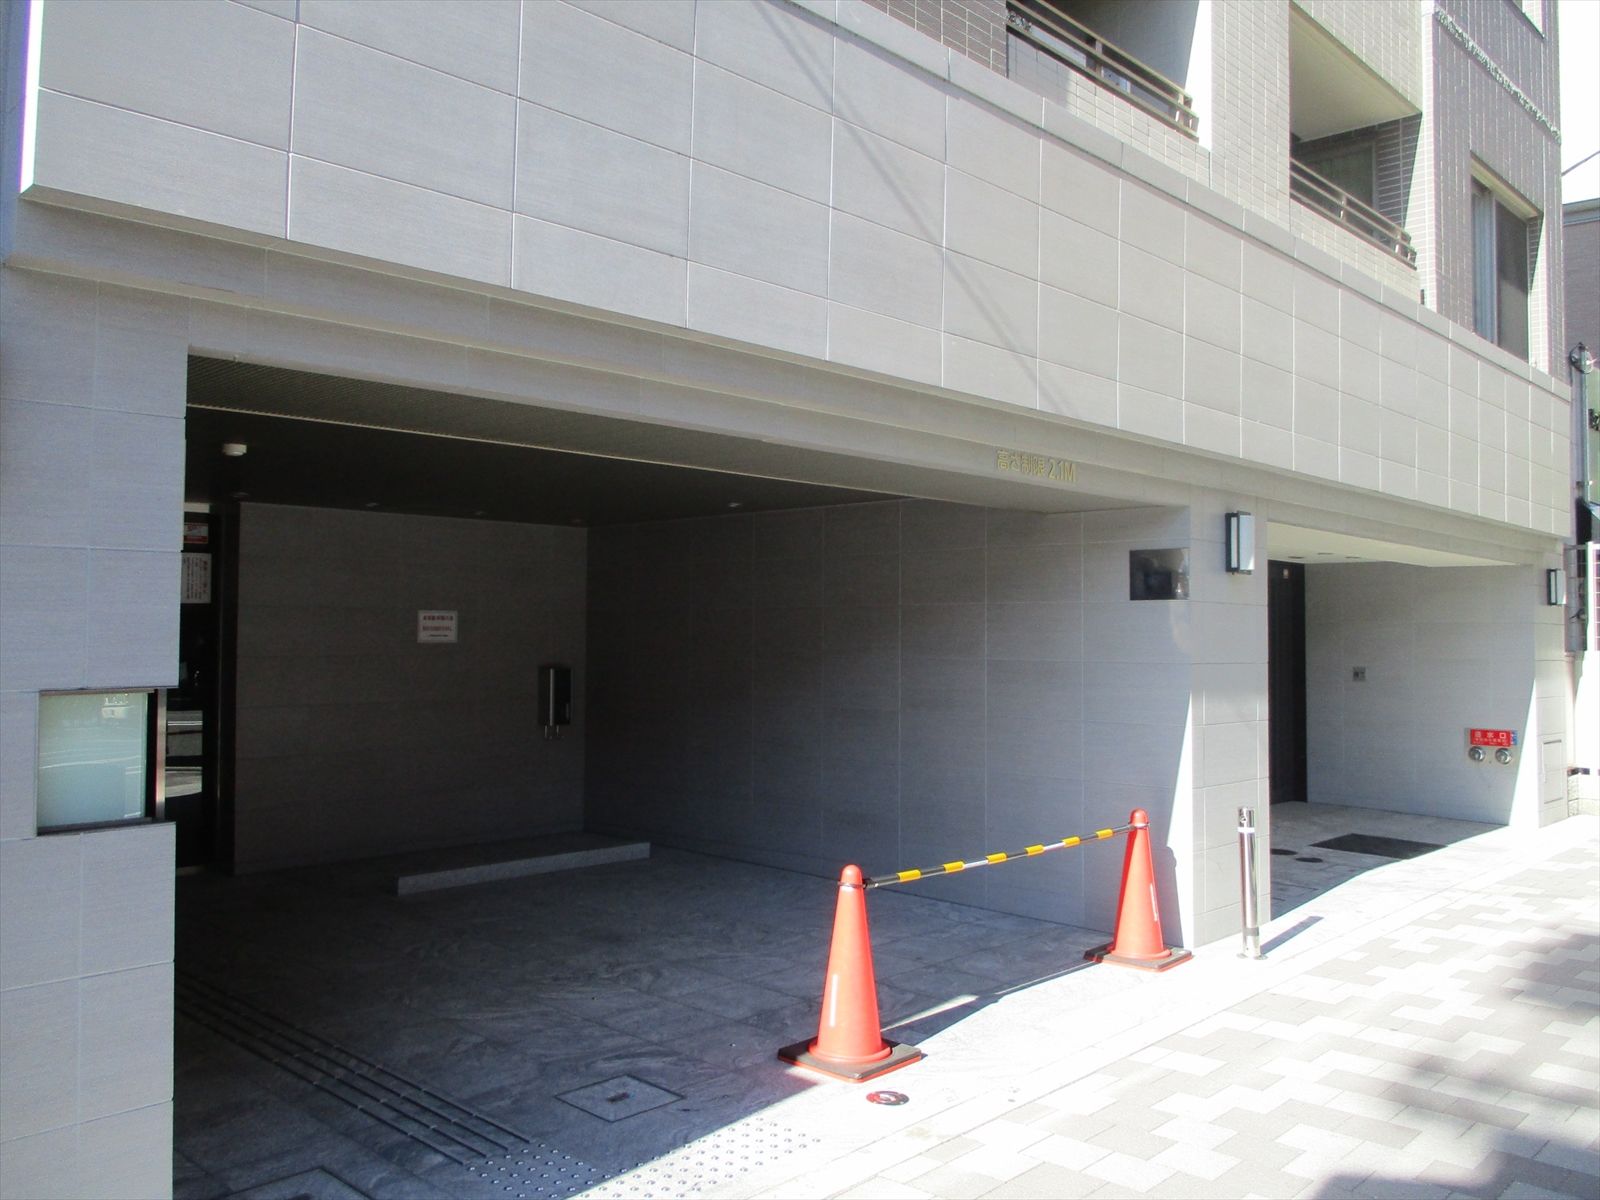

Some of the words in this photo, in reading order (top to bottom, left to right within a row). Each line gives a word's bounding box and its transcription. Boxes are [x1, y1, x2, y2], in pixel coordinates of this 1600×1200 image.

[996, 448, 1045, 477] 高さ制限
[1048, 458, 1077, 482] 2.1M
